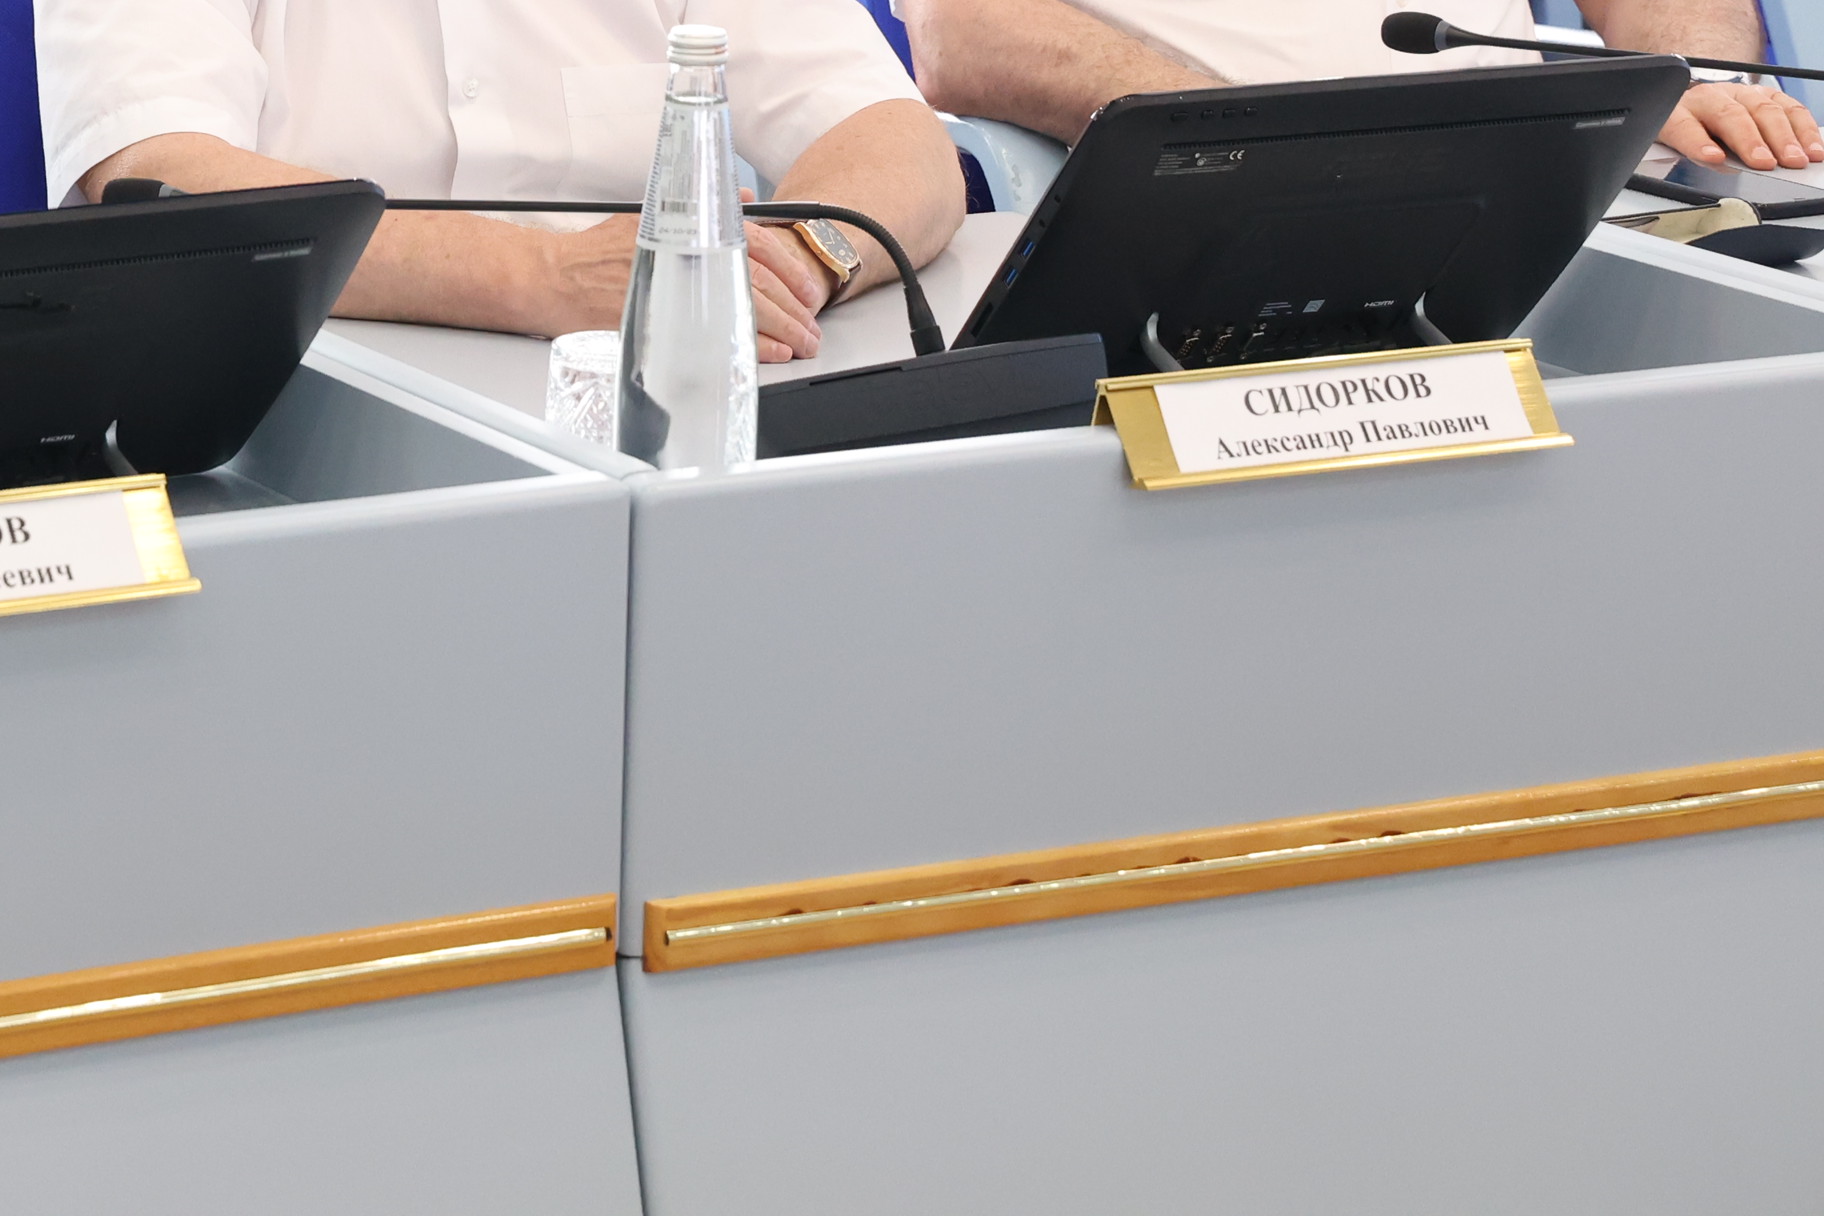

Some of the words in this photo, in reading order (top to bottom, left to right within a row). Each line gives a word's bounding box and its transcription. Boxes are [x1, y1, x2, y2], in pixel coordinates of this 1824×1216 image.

[1243, 371, 1433, 418] СИДОРКОВ
[1215, 427, 1355, 461] Александр
[1359, 412, 1491, 443] Павлович
